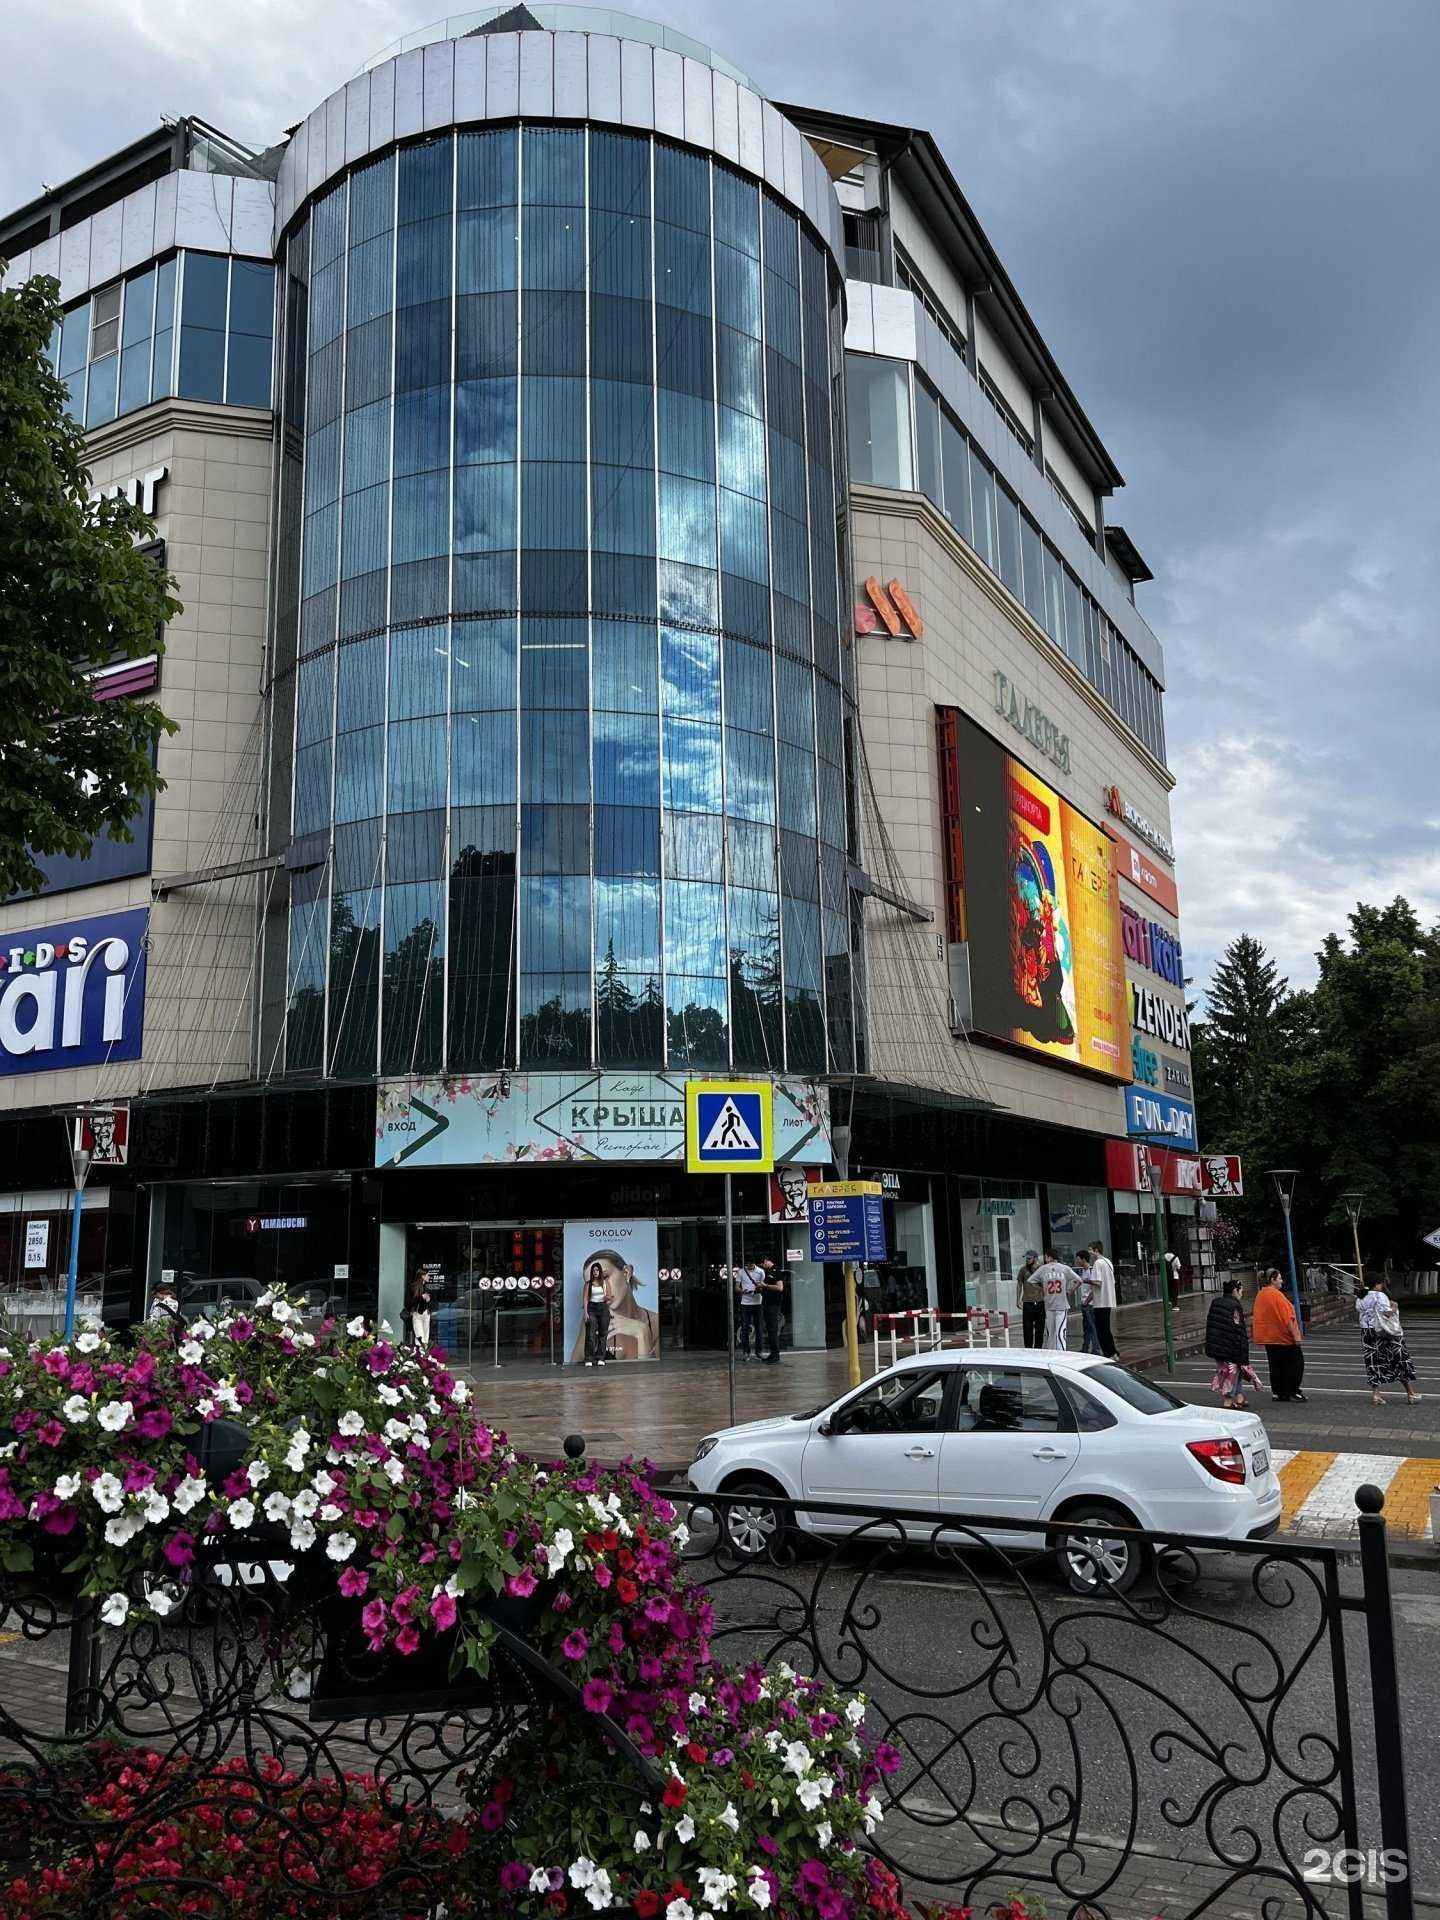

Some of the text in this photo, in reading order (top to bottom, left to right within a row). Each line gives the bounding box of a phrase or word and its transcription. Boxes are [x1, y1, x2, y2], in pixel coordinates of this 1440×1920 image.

[1121, 912, 1152, 970] ari
[0, 937, 129, 1055] ari
[1133, 982, 1191, 1050] ZENDEN
[571, 1106, 685, 1127] КРЫША
[783, 1118, 804, 1127] ЛИФТ
[387, 1121, 417, 1132] ВХОД
[260, 1217, 306, 1229] YAMAGUCHI
[588, 1229, 633, 1238] SOKOLOV
[1047, 1280, 1063, 1295] 23
